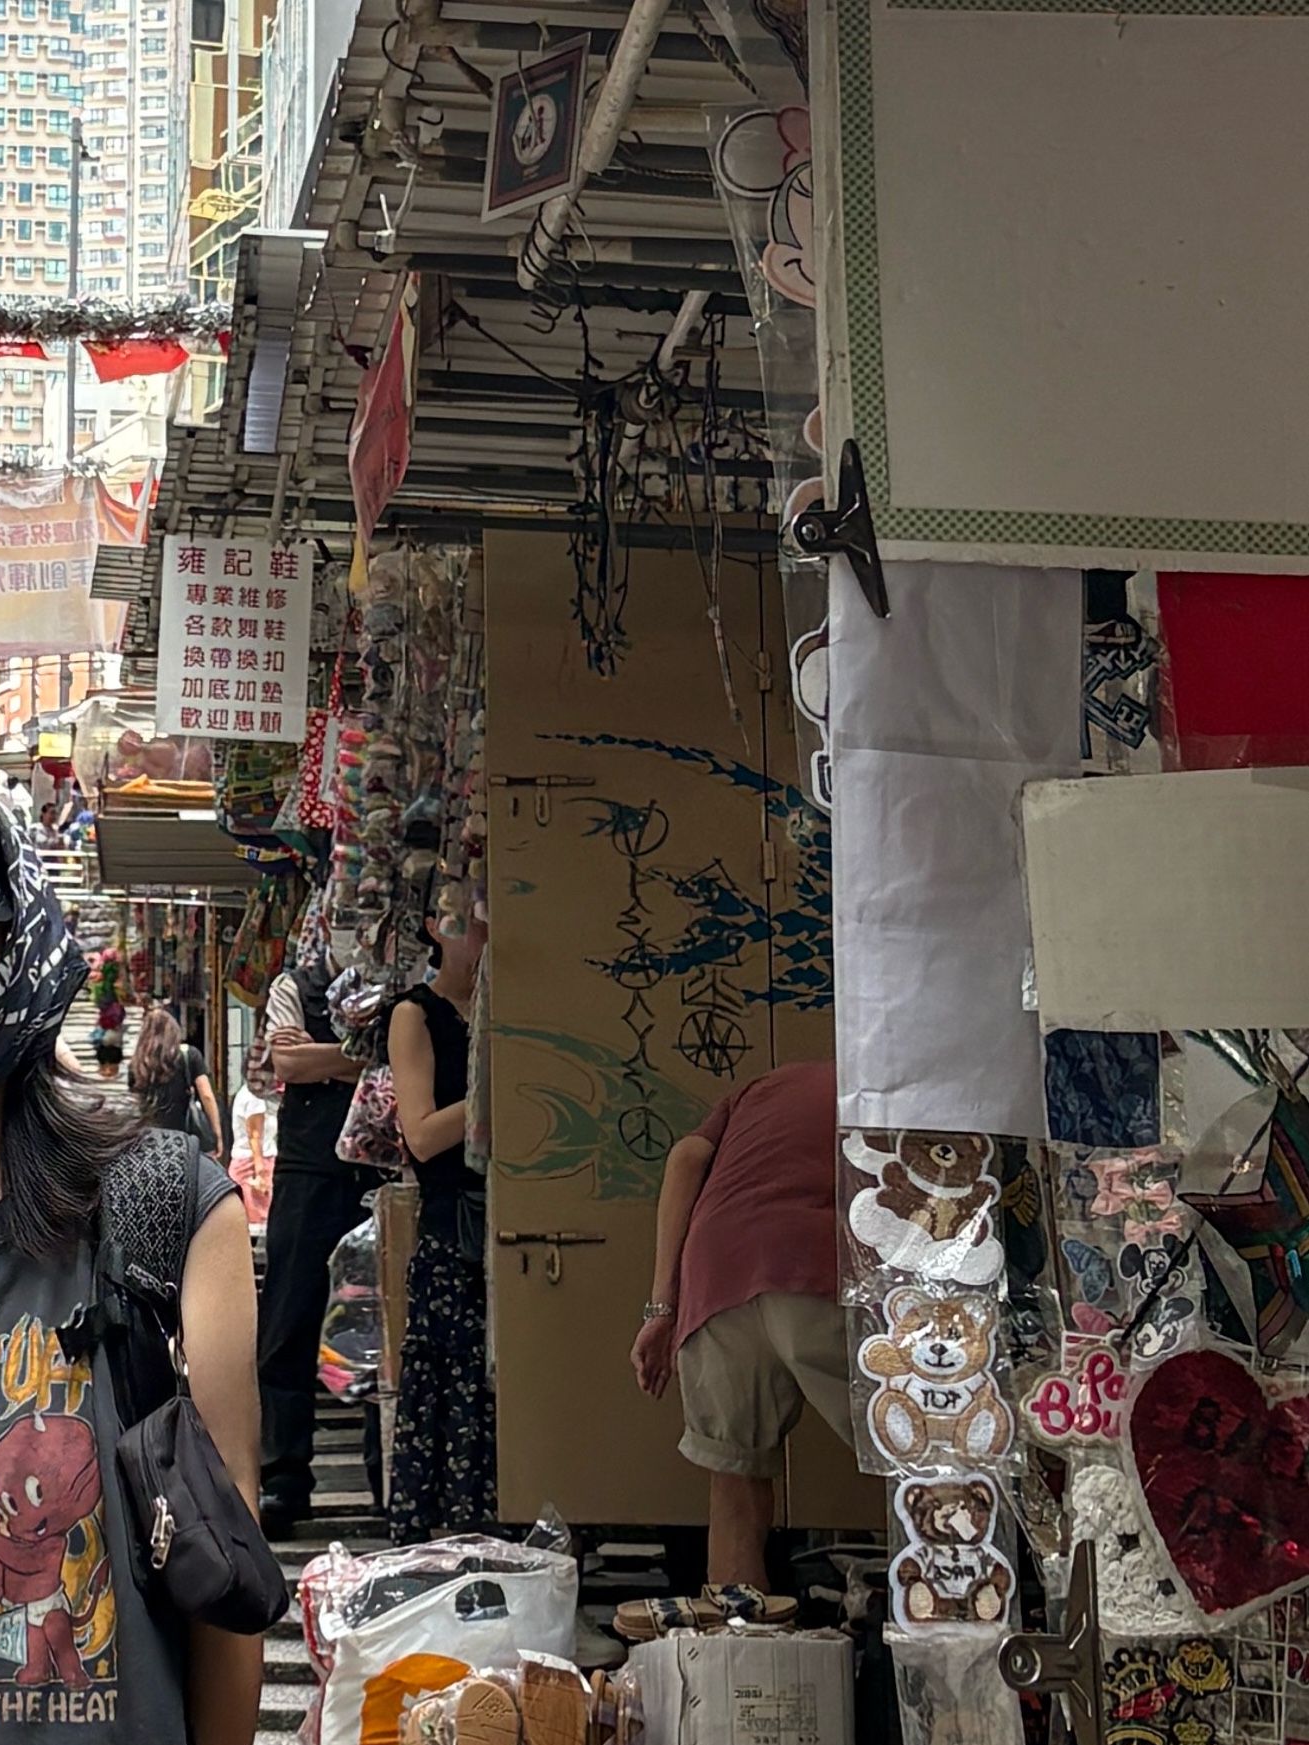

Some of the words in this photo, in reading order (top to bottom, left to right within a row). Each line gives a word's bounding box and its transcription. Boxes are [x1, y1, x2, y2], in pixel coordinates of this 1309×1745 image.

[186, 583, 288, 610] 專業維修
[184, 614, 286, 642] 各款舞鞋
[183, 646, 285, 673] 換帶換扣
[180, 677, 283, 704] 加底加墊
[179, 706, 282, 734] 歡迎惠顧
[47, 1690, 118, 1725] HEAT
